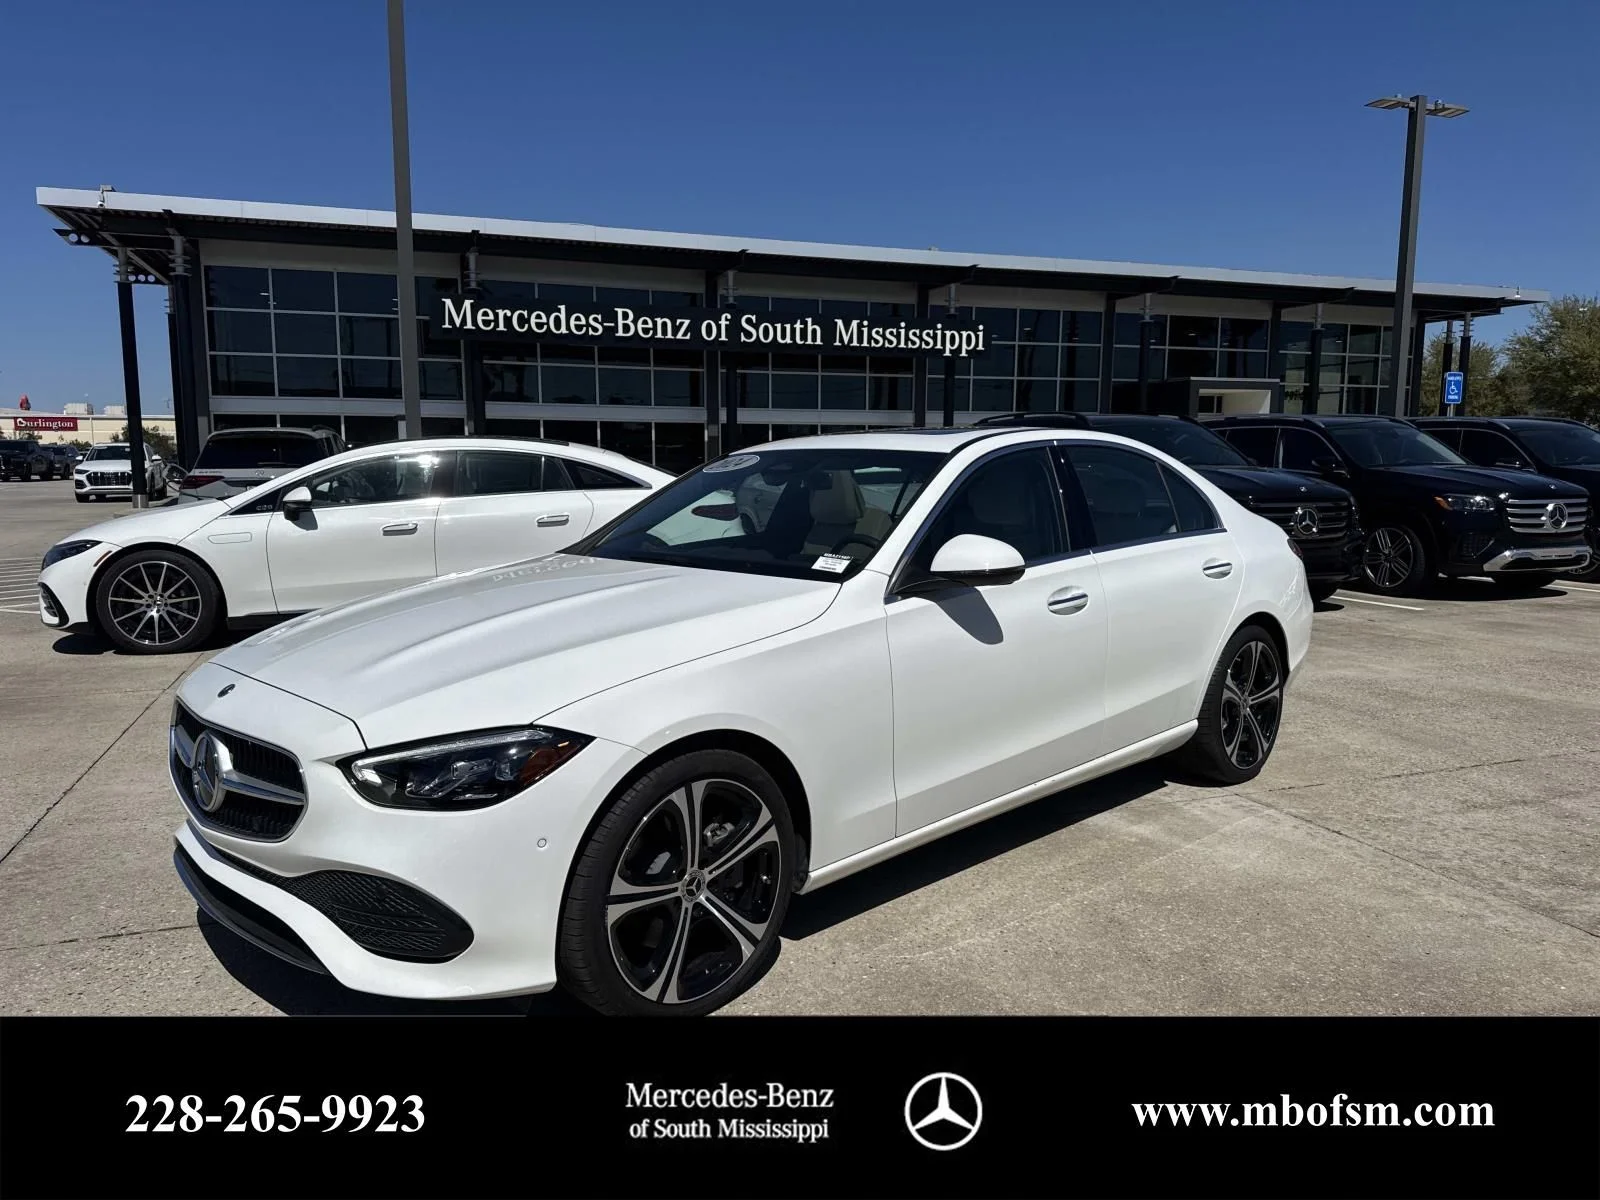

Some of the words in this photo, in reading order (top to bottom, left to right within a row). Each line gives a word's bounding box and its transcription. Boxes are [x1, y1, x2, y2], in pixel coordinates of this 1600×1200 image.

[441, 298, 691, 340] Mercedes-Benz
[701, 312, 732, 341] of
[740, 314, 823, 345] South
[833, 318, 985, 357] Mississippi
[17, 418, 74, 430] Burlington
